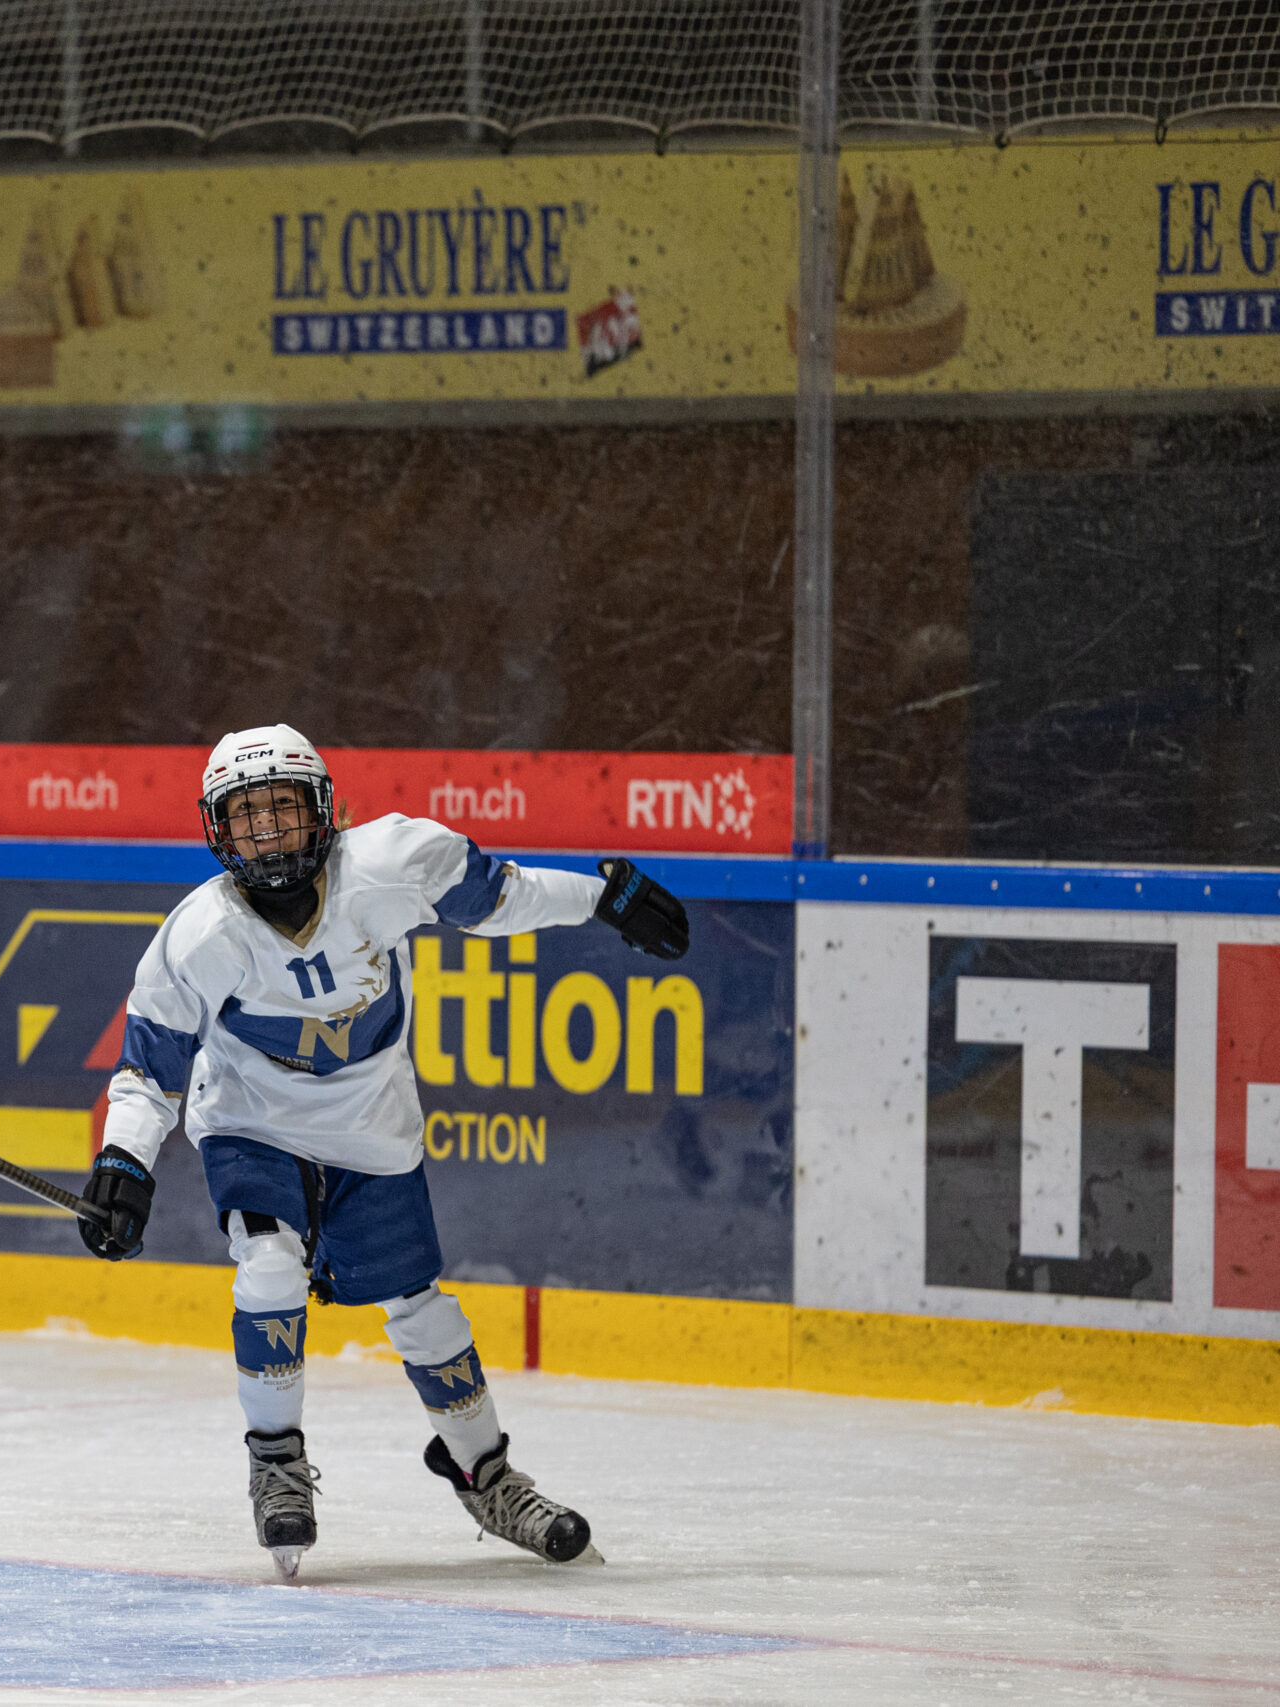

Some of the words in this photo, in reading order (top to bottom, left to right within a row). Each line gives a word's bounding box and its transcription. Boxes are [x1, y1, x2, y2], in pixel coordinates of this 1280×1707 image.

[272, 211, 328, 301] LE
[340, 189, 570, 299] GRUYÈRE
[1156, 182, 1223, 276] LE
[282, 313, 555, 351] SWITZERLAND
[235, 749, 274, 763] CCM
[28, 771, 118, 810] rtn.ch
[430, 779, 526, 821] rtn.ch
[627, 778, 713, 829] RTN
[285, 950, 337, 999] 11
[955, 976, 1150, 1259] T
[261, 1358, 304, 1378] NHA
[448, 1383, 486, 1413] NHA
